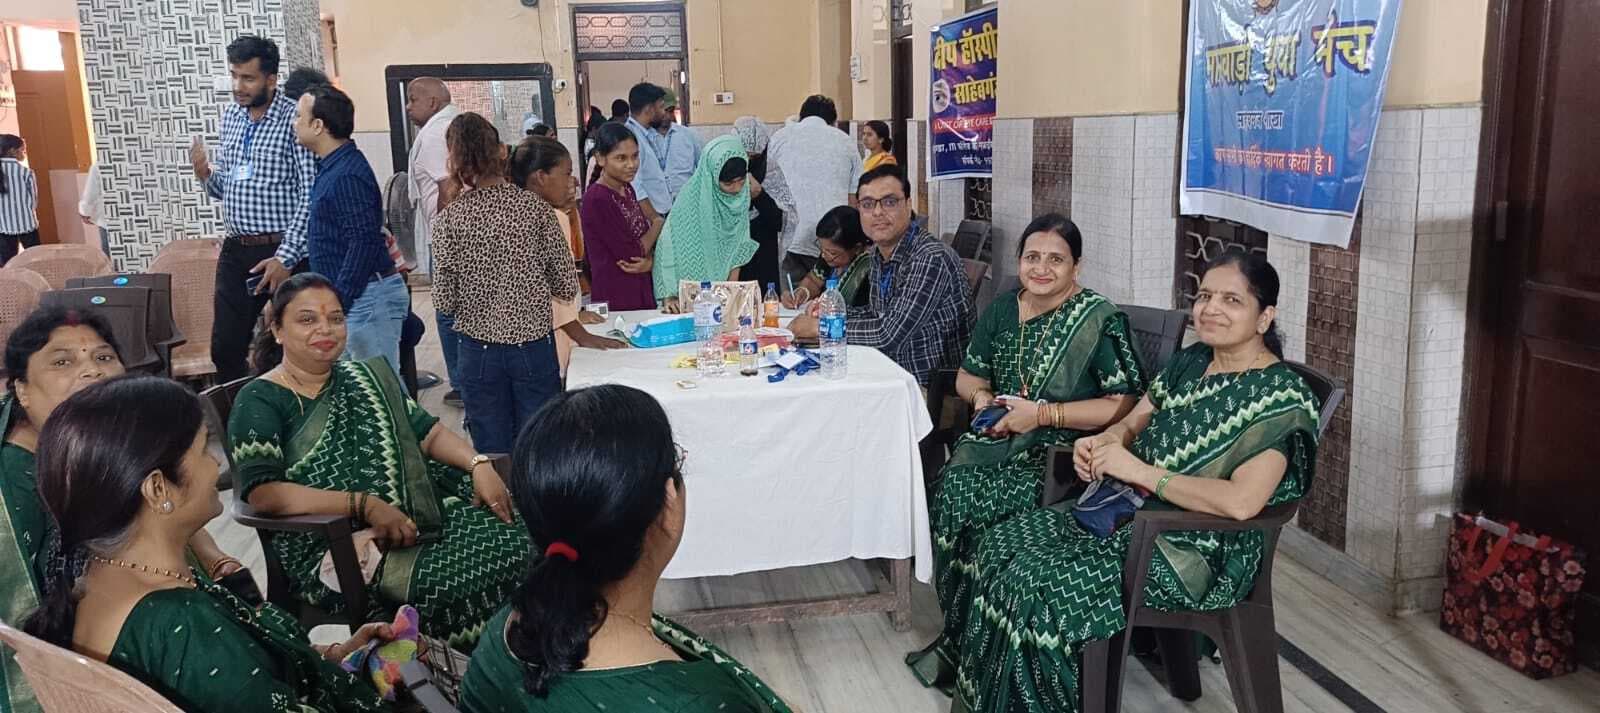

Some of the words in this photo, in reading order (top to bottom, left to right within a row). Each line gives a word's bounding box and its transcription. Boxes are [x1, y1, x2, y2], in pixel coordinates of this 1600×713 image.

[934, 36, 957, 69] दीप
[959, 22, 997, 65] हॉस्पी
[1311, 10, 1376, 77] मंच
[1263, 151, 1285, 169] स्वागत
[1288, 147, 1312, 172] करती
